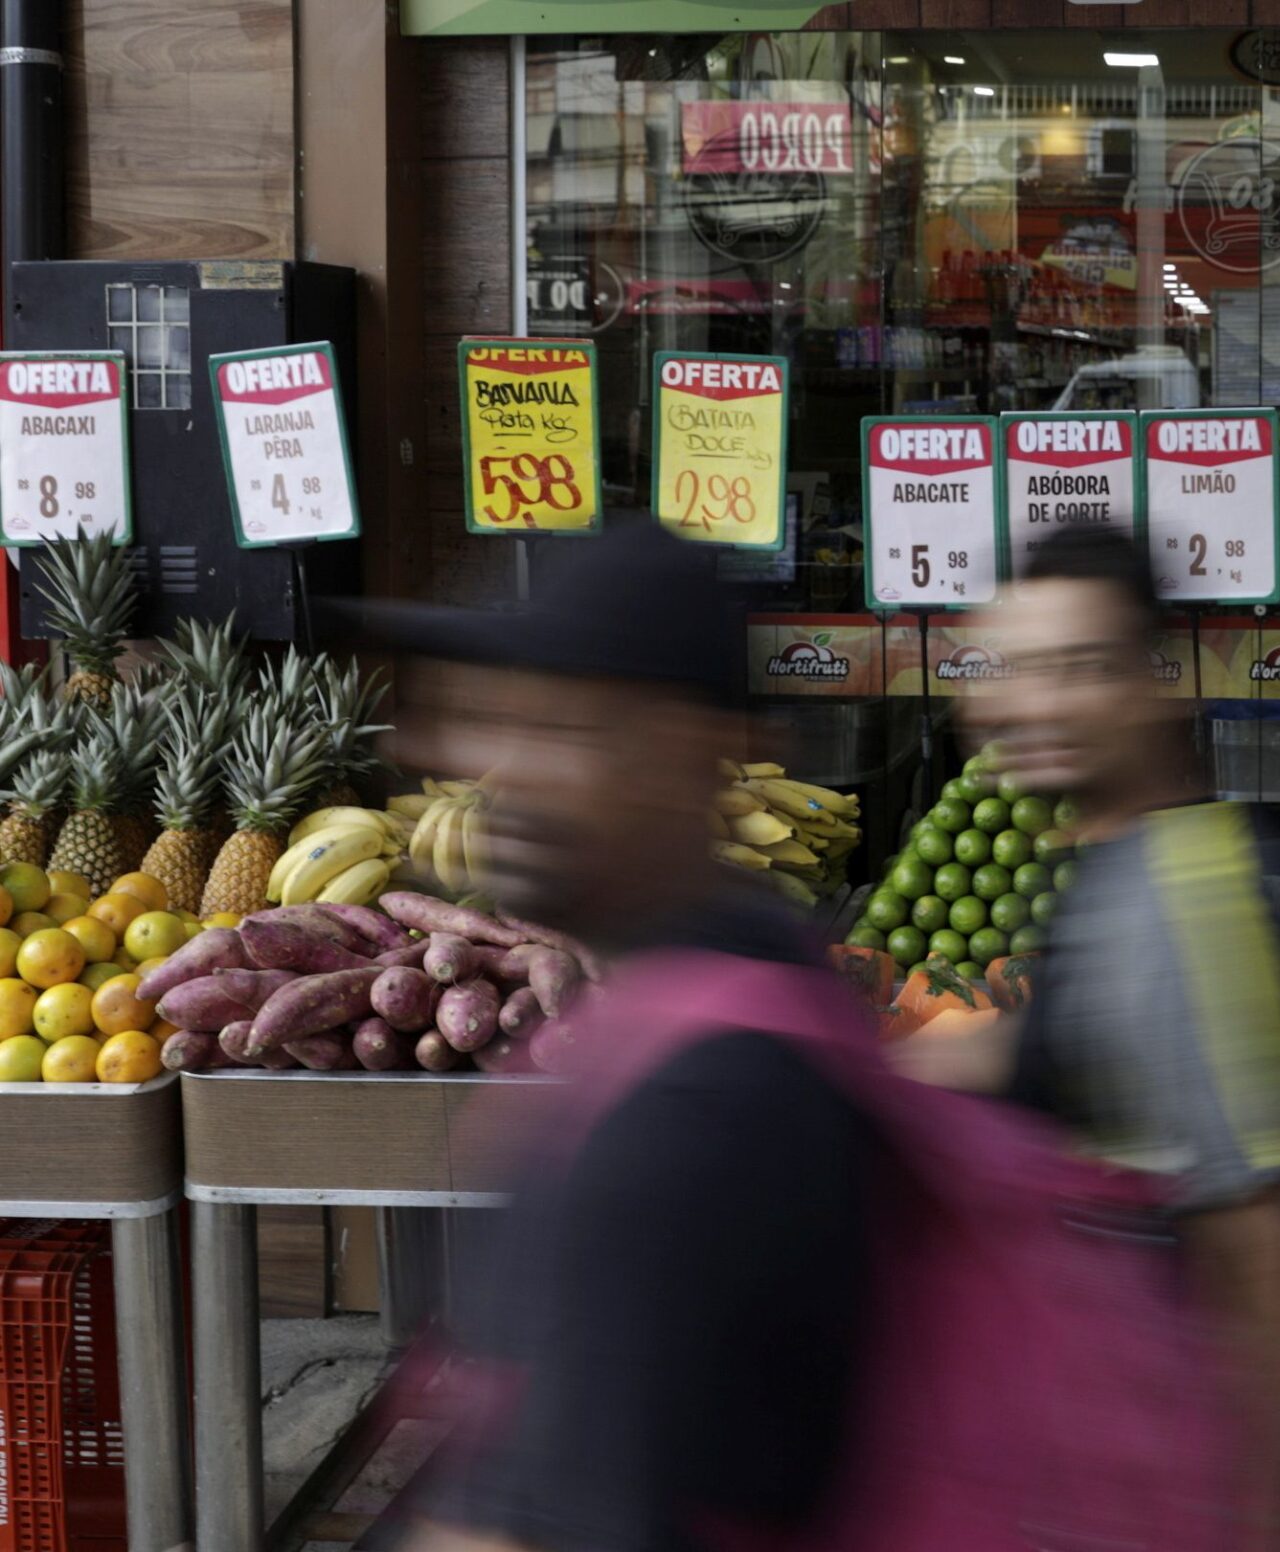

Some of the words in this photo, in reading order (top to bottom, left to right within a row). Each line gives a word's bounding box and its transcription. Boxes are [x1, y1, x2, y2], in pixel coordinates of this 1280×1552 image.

[8, 362, 112, 395] OFERTA
[226, 353, 325, 395] OFERTA
[661, 361, 780, 391] OFERTA
[475, 380, 579, 408] BANANA
[21, 416, 96, 437] ABACAXI
[245, 411, 315, 437] LARANJA
[668, 403, 755, 432] BATATA
[264, 436, 304, 460] PÊRA
[687, 435, 746, 452] DOCE
[880, 428, 984, 461] OFERTA
[1017, 421, 1123, 453] OFERTA
[1158, 421, 1262, 453] OFERTA
[75, 482, 95, 499] 98
[302, 476, 321, 495] 98
[893, 483, 969, 504] ABACATE
[1027, 471, 1110, 496] ABÓBORA
[1181, 470, 1236, 495] LIMÃO
[1028, 502, 1050, 523] DE
[1055, 501, 1110, 523] CORTE
[889, 548, 901, 560] R$
[948, 551, 968, 569] 98
[1166, 537, 1178, 550] R$
[1225, 540, 1245, 558] 98
[953, 580, 966, 596] kg
[1230, 569, 1242, 583] kg
[768, 658, 848, 676] Hortifruti
